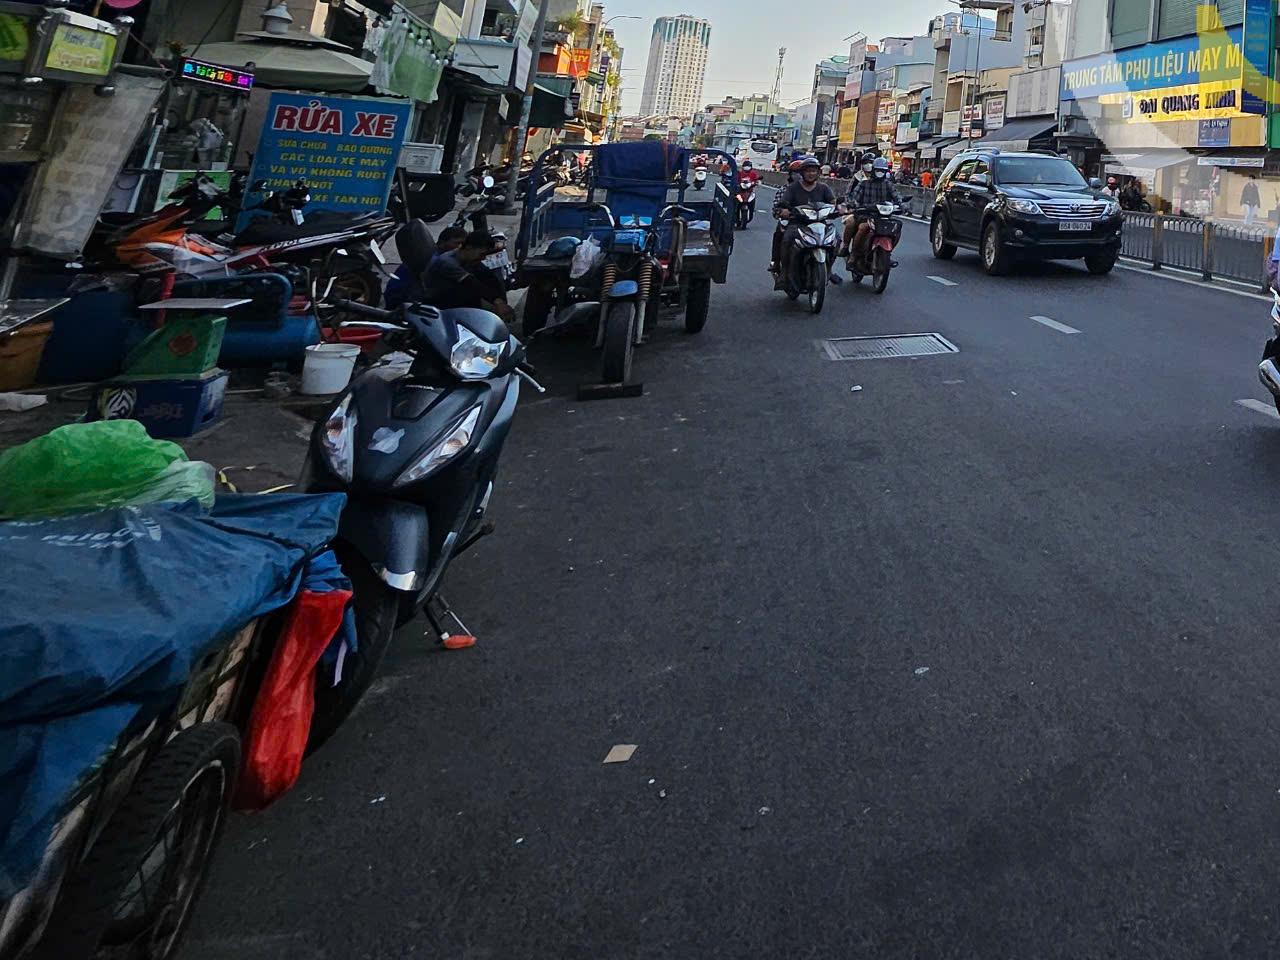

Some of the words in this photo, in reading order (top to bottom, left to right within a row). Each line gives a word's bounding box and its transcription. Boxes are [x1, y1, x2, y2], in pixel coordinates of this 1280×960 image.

[1063, 66, 1097, 91] TRUNG
[1099, 60, 1123, 85] TÂM
[1125, 57, 1151, 86] PHỤ
[1153, 50, 1184, 82] LIỆU
[1187, 46, 1222, 74] MAY
[1139, 97, 1158, 119] ĐẠI
[1161, 93, 1200, 115] QUANG
[1204, 89, 1236, 111] MINH
[271, 100, 343, 136] RỬA
[351, 111, 398, 139] XE
[340, 156, 357, 166] XE
[312, 193, 329, 203] XE
